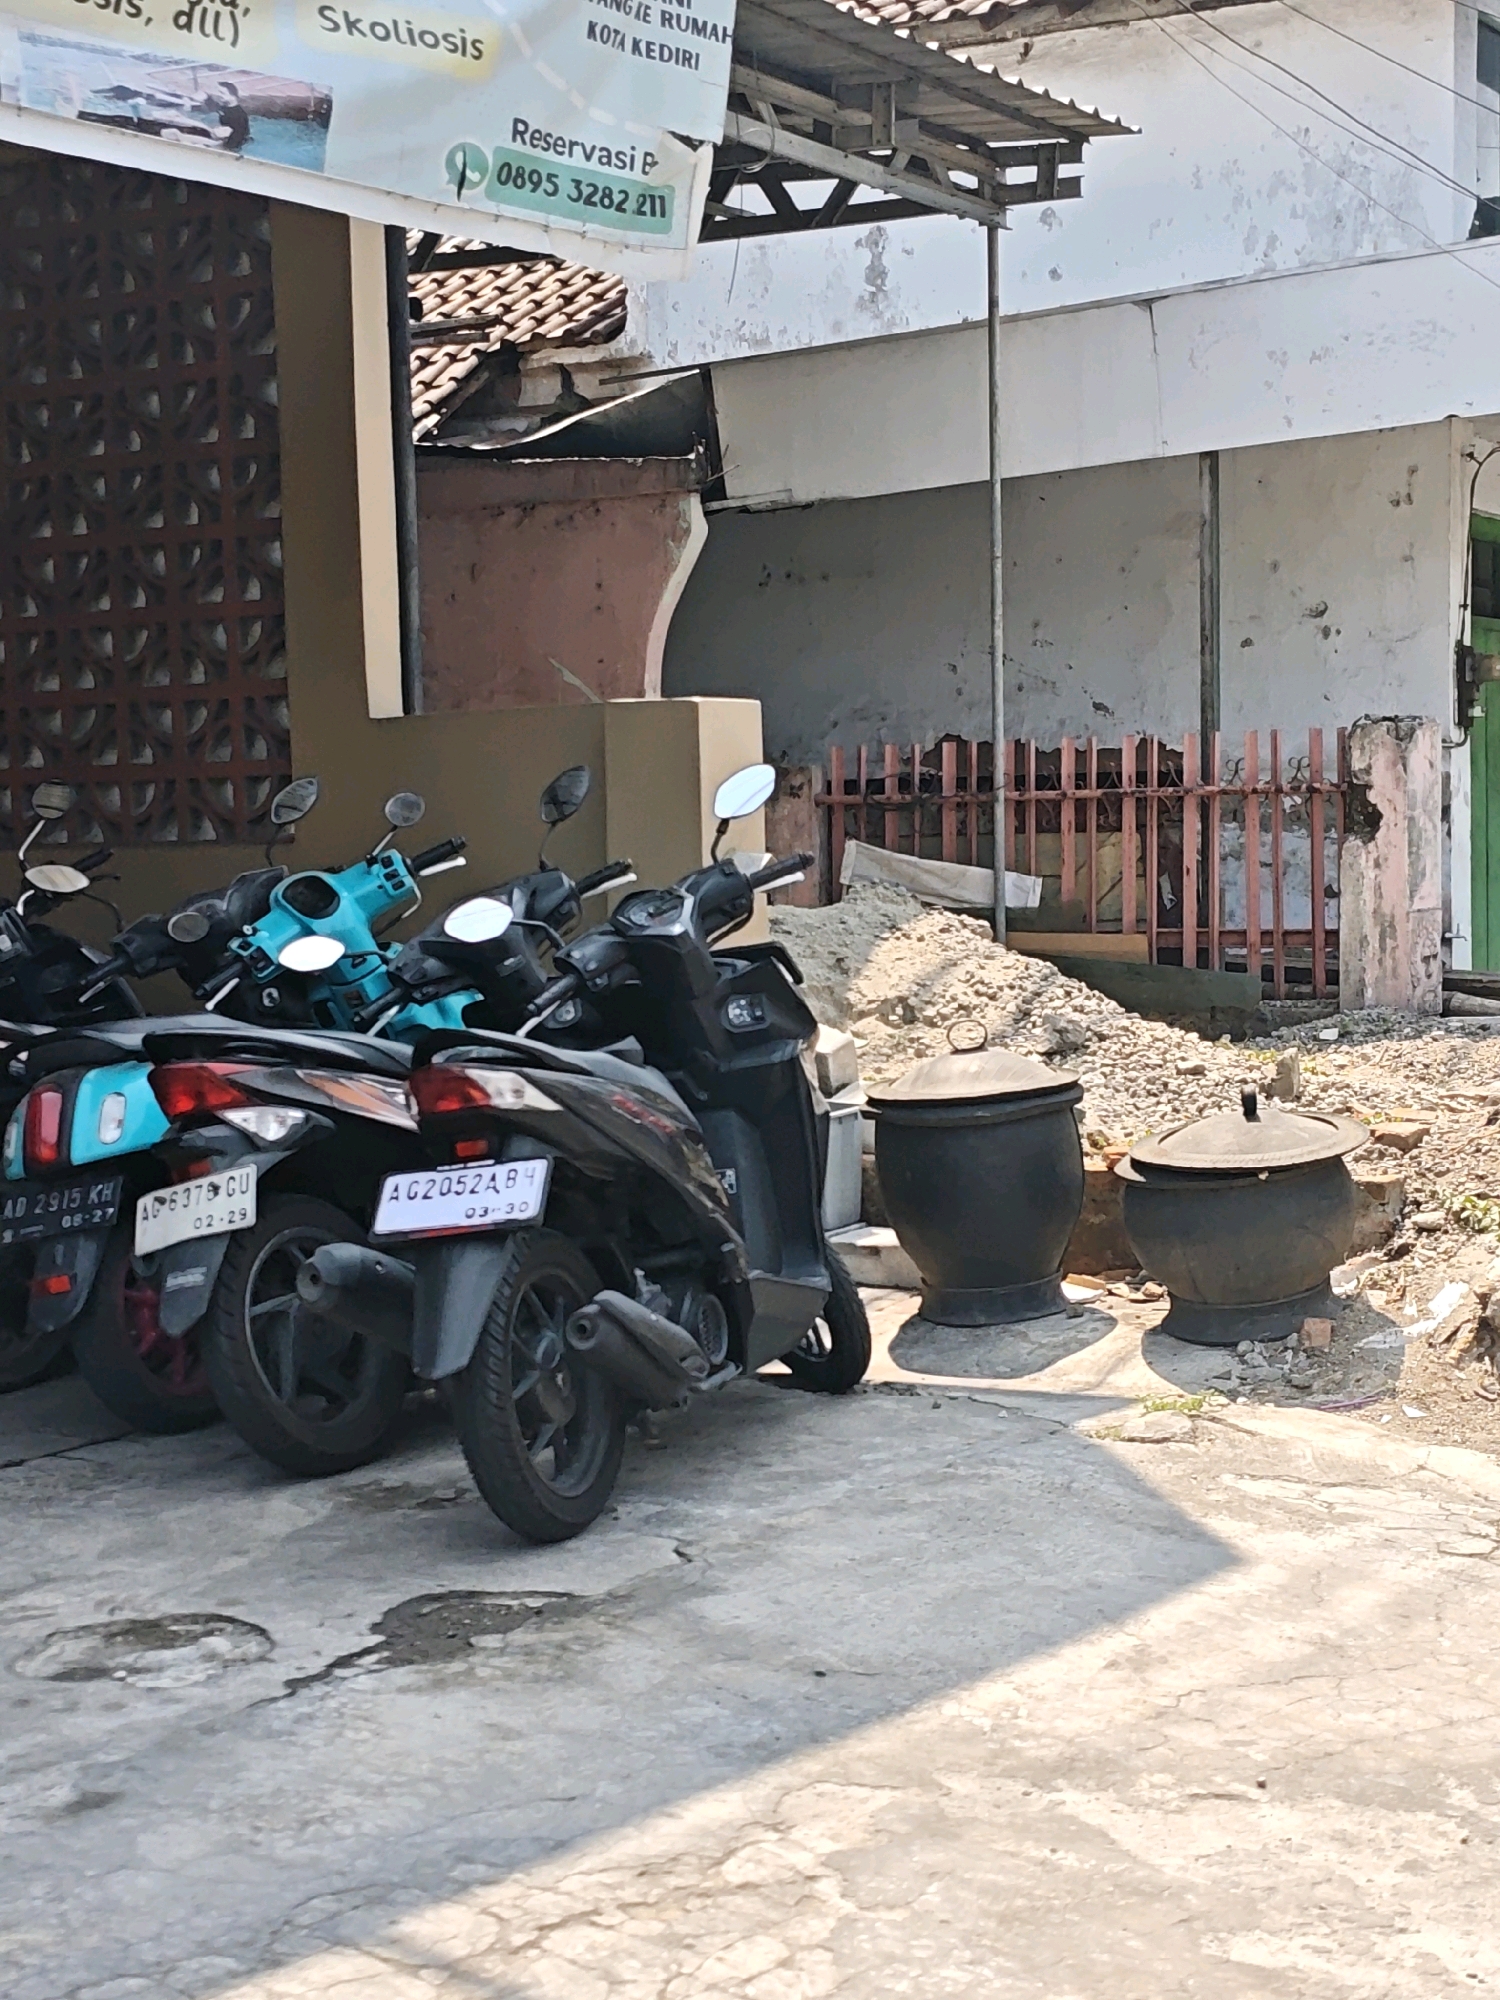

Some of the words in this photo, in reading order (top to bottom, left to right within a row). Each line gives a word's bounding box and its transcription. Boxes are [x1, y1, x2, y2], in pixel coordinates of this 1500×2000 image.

[317, 5, 485, 61] Skoliosis
[587, 20, 626, 52] KOTA
[630, 36, 700, 71] KEDIRI
[660, 9, 735, 44] RUMAH
[511, 117, 636, 172] Reservasi
[496, 161, 559, 197] 0895
[566, 178, 629, 214] 3282
[87, 1182, 114, 1204] KH
[226, 1172, 250, 1197] GU
